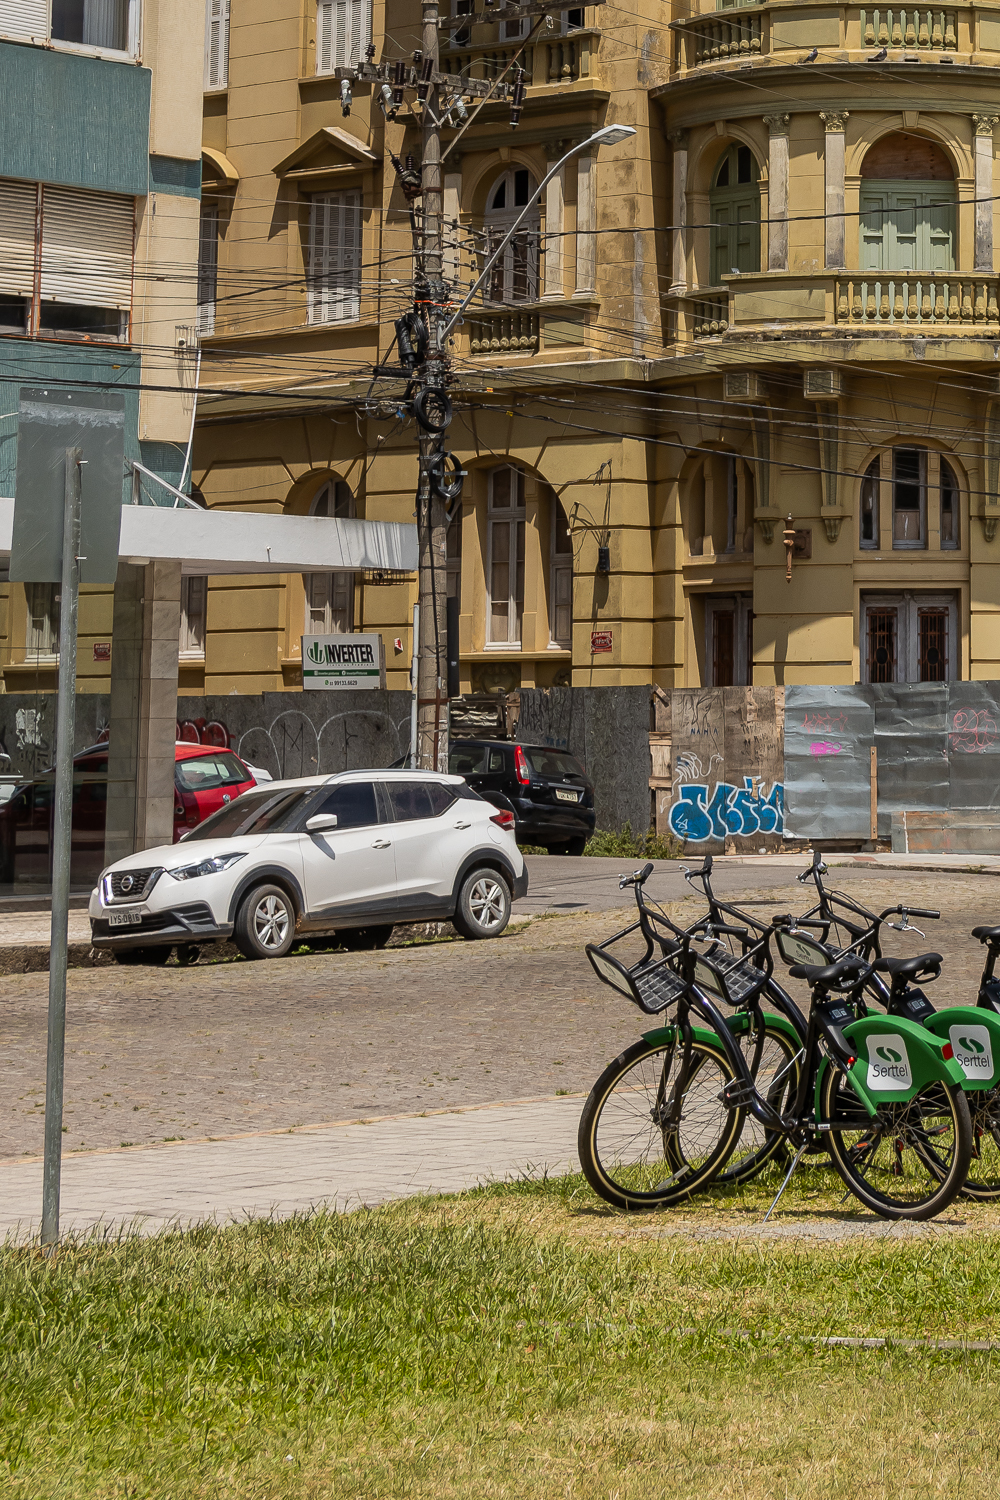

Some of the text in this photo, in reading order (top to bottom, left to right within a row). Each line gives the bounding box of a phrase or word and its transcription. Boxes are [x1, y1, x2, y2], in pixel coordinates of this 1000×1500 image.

[324, 644, 374, 663] INVERTER
[956, 1053, 990, 1068] Serttel
[872, 1063, 909, 1078] Serttel
